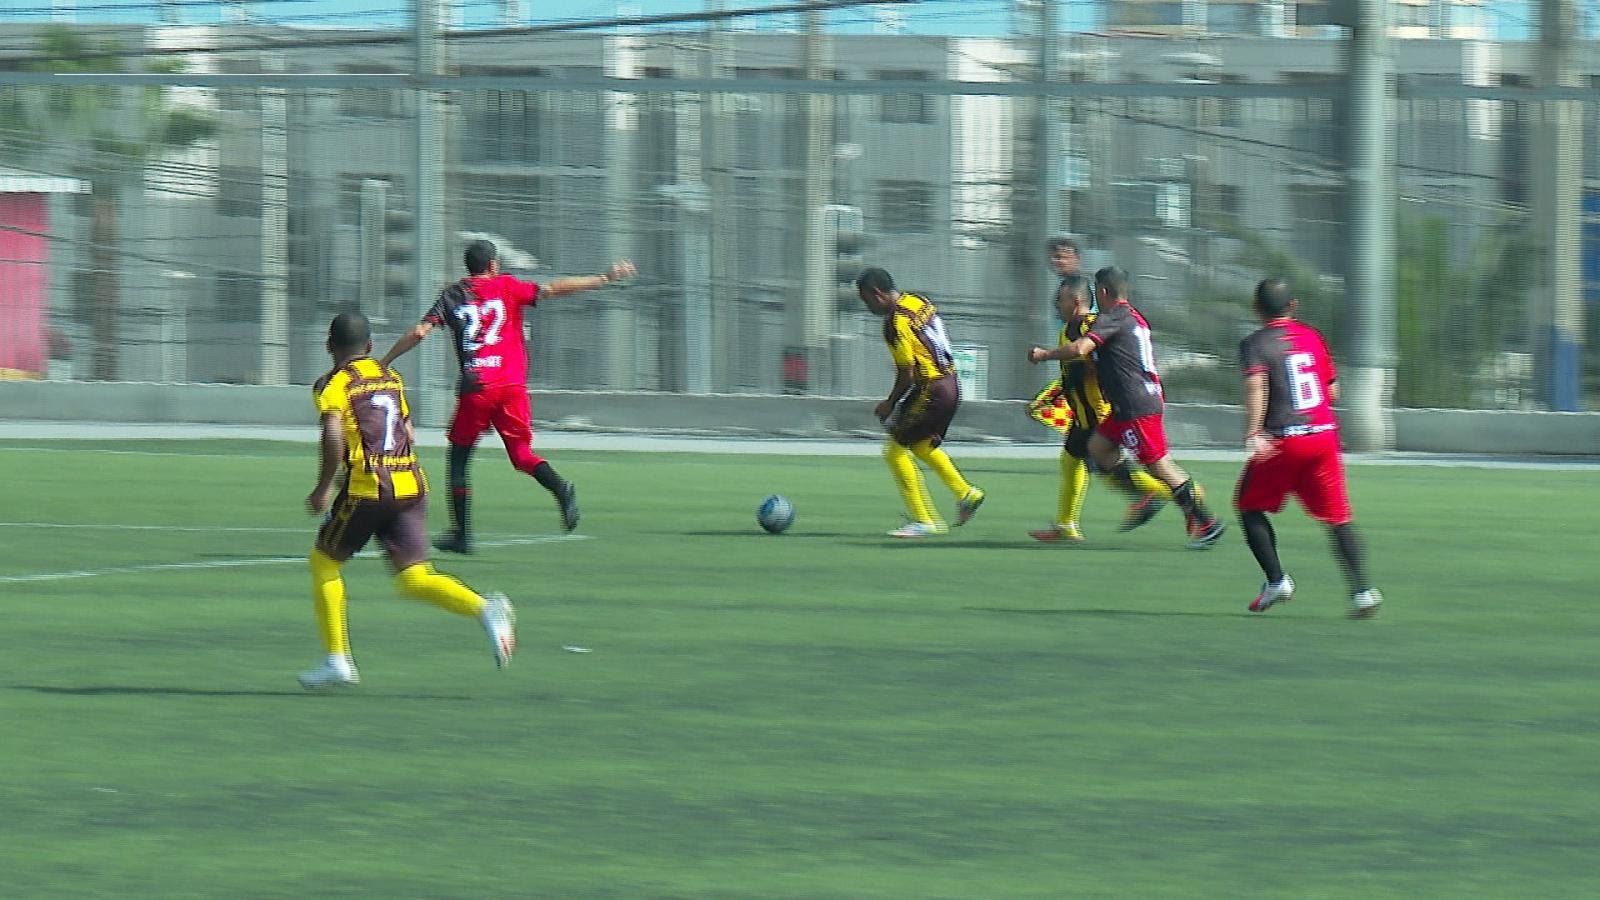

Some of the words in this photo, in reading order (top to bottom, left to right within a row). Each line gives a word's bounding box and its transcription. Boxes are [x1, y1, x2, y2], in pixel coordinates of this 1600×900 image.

[453, 298, 507, 351] 22
[1285, 353, 1324, 410] 6
[370, 394, 399, 451] 7
